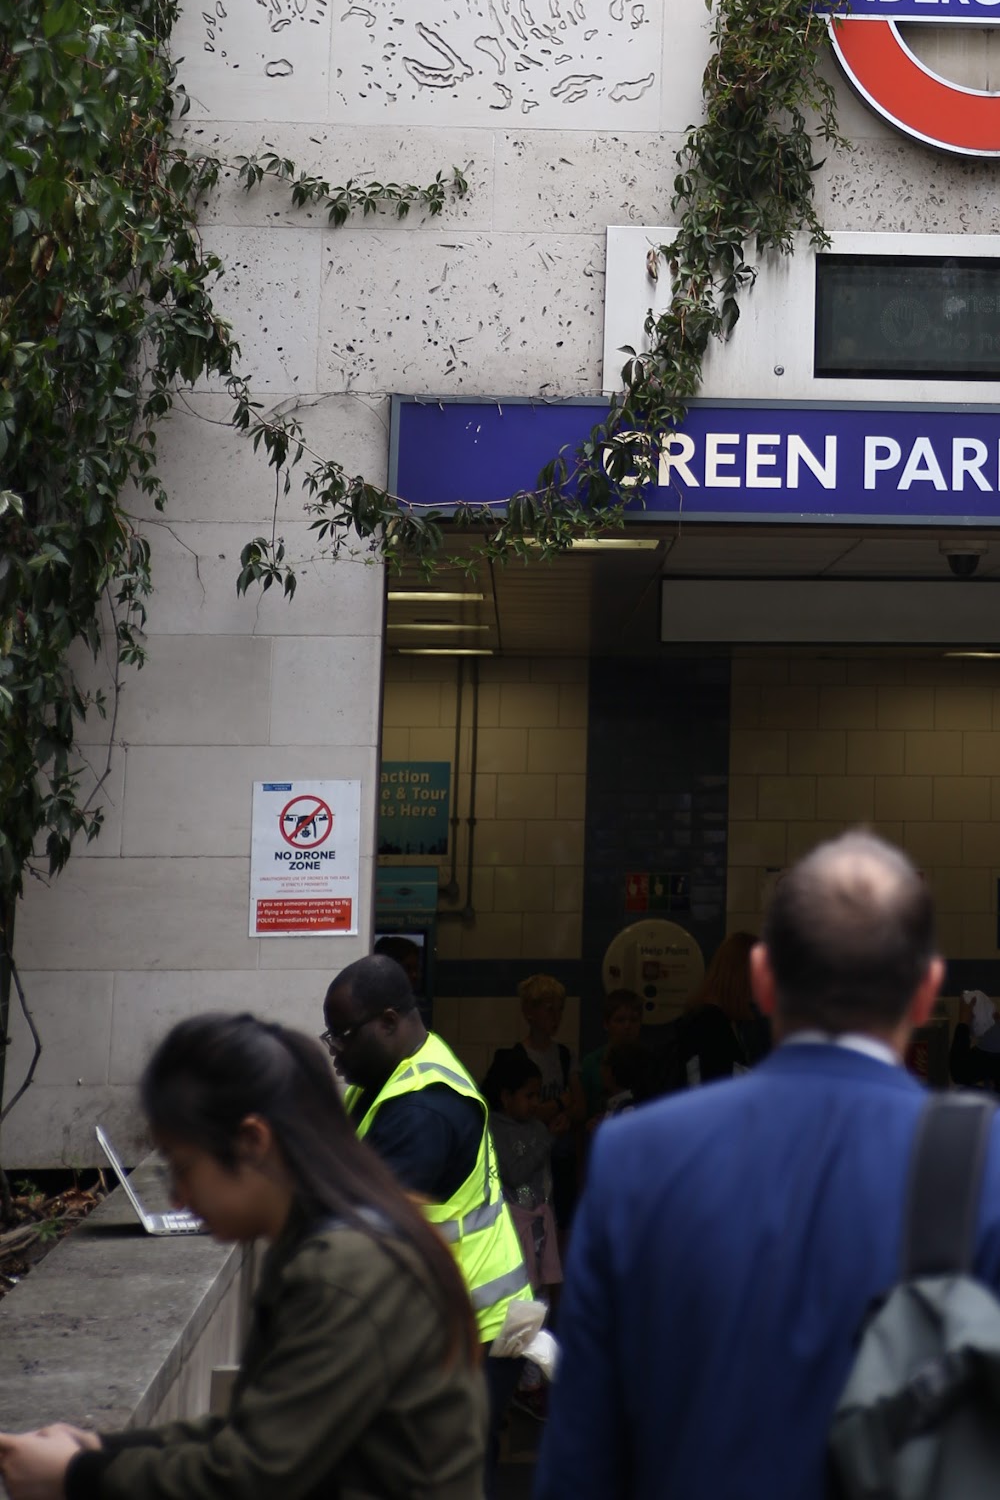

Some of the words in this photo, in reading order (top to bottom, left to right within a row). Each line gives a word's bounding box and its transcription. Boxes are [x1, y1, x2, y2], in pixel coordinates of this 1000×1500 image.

[411, 787, 447, 800] Tour
[400, 803, 437, 817] Here
[274, 851, 292, 860] NO
[295, 850, 336, 860] DRONE
[288, 861, 321, 870] ZONE
[276, 916, 310, 924] immediately
